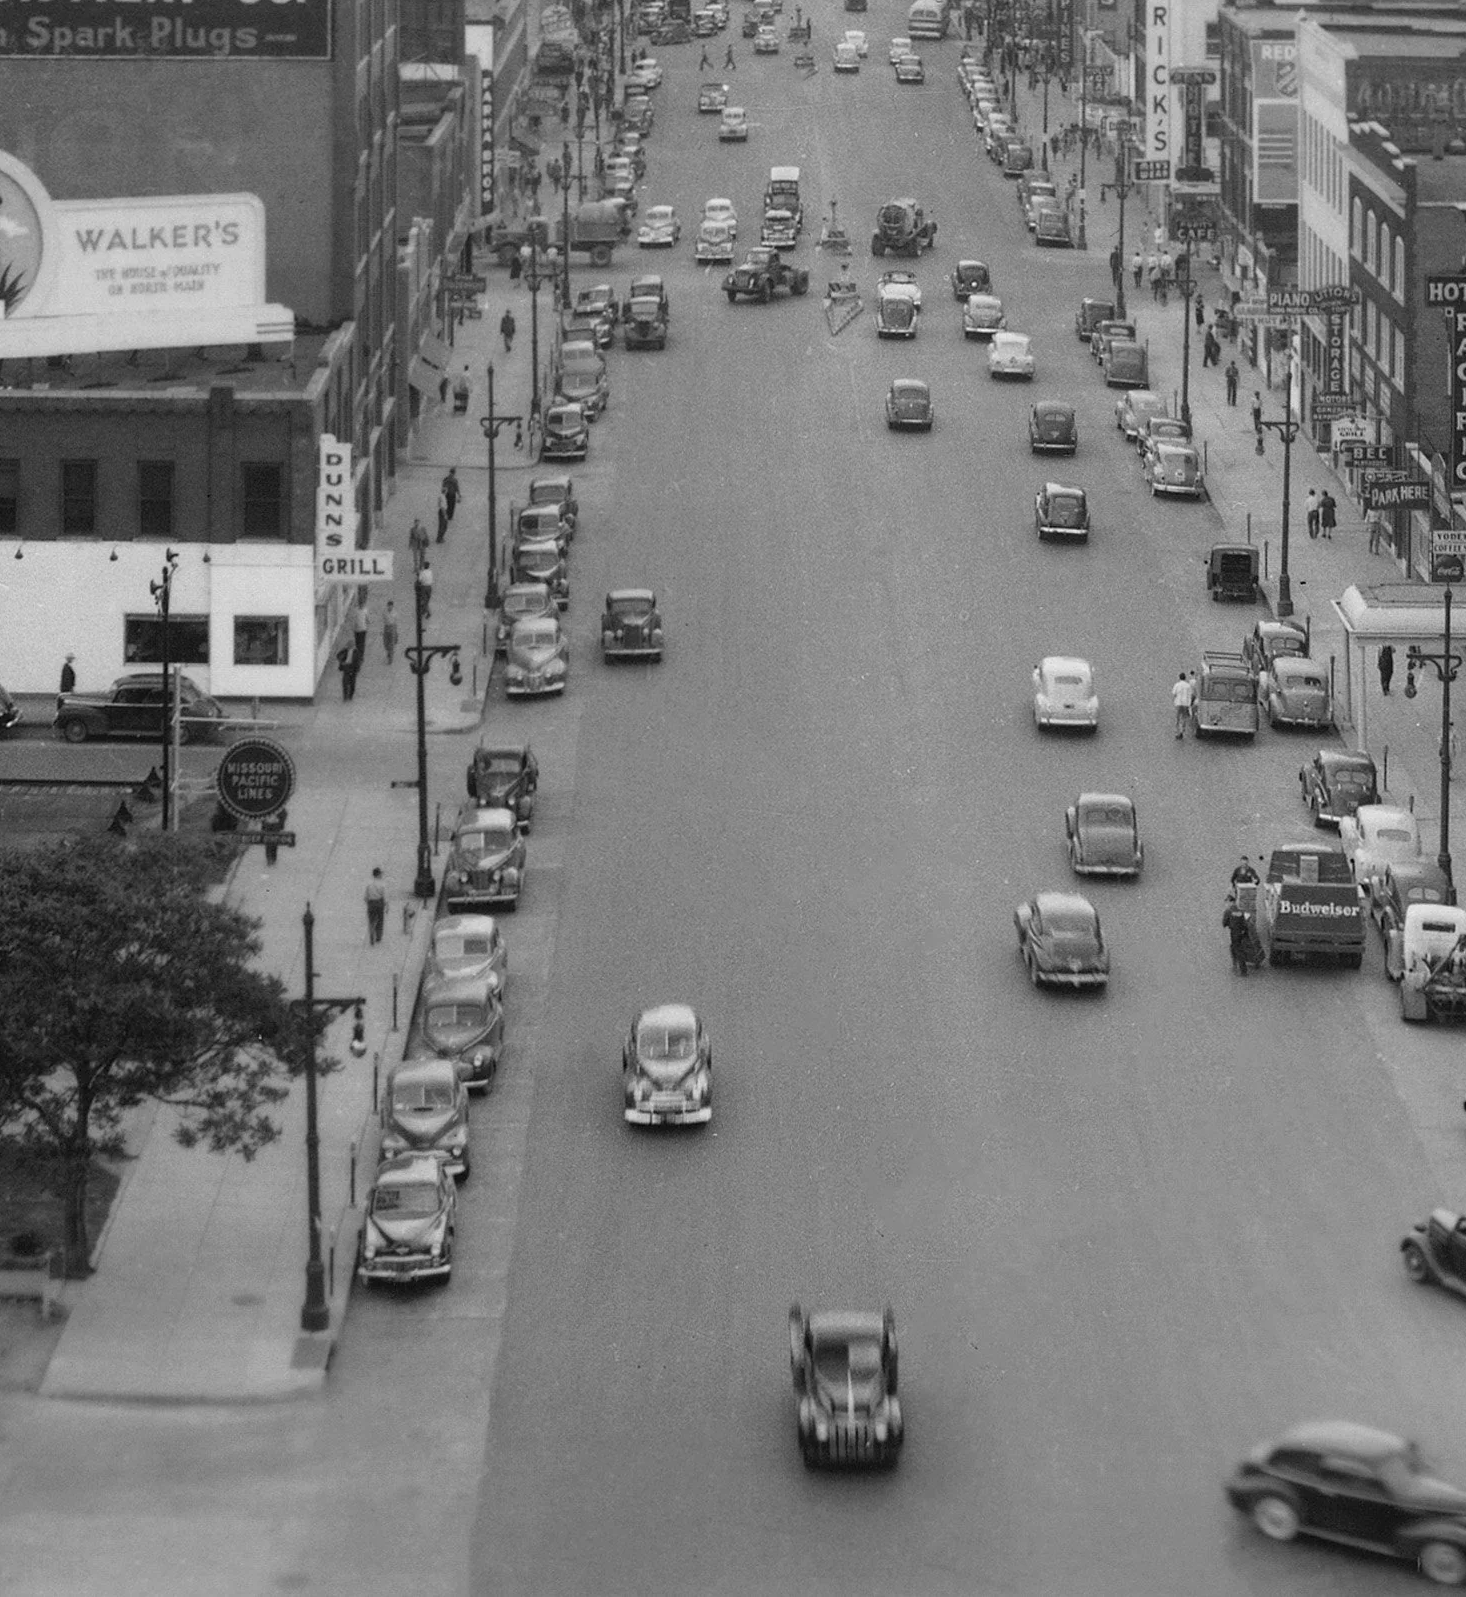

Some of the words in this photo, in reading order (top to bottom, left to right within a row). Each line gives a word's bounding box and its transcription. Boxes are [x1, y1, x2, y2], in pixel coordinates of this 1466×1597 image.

[26, 15, 132, 53] Spark
[151, 16, 259, 55] Plugs
[75, 220, 240, 252] WALKER'S
[1177, 228, 1216, 239] CAFE
[1270, 293, 1310, 306] PIANO
[1330, 314, 1341, 392] STORAGE
[325, 453, 343, 547] DUNNS
[1372, 487, 1400, 506] PARK
[1400, 485, 1430, 500] HERE
[322, 558, 386, 575] GRILL
[227, 762, 283, 774] MISSOURI
[232, 775, 279, 786] PACIFIC
[238, 788, 274, 799] LINES
[1280, 900, 1360, 916] Budweiser
